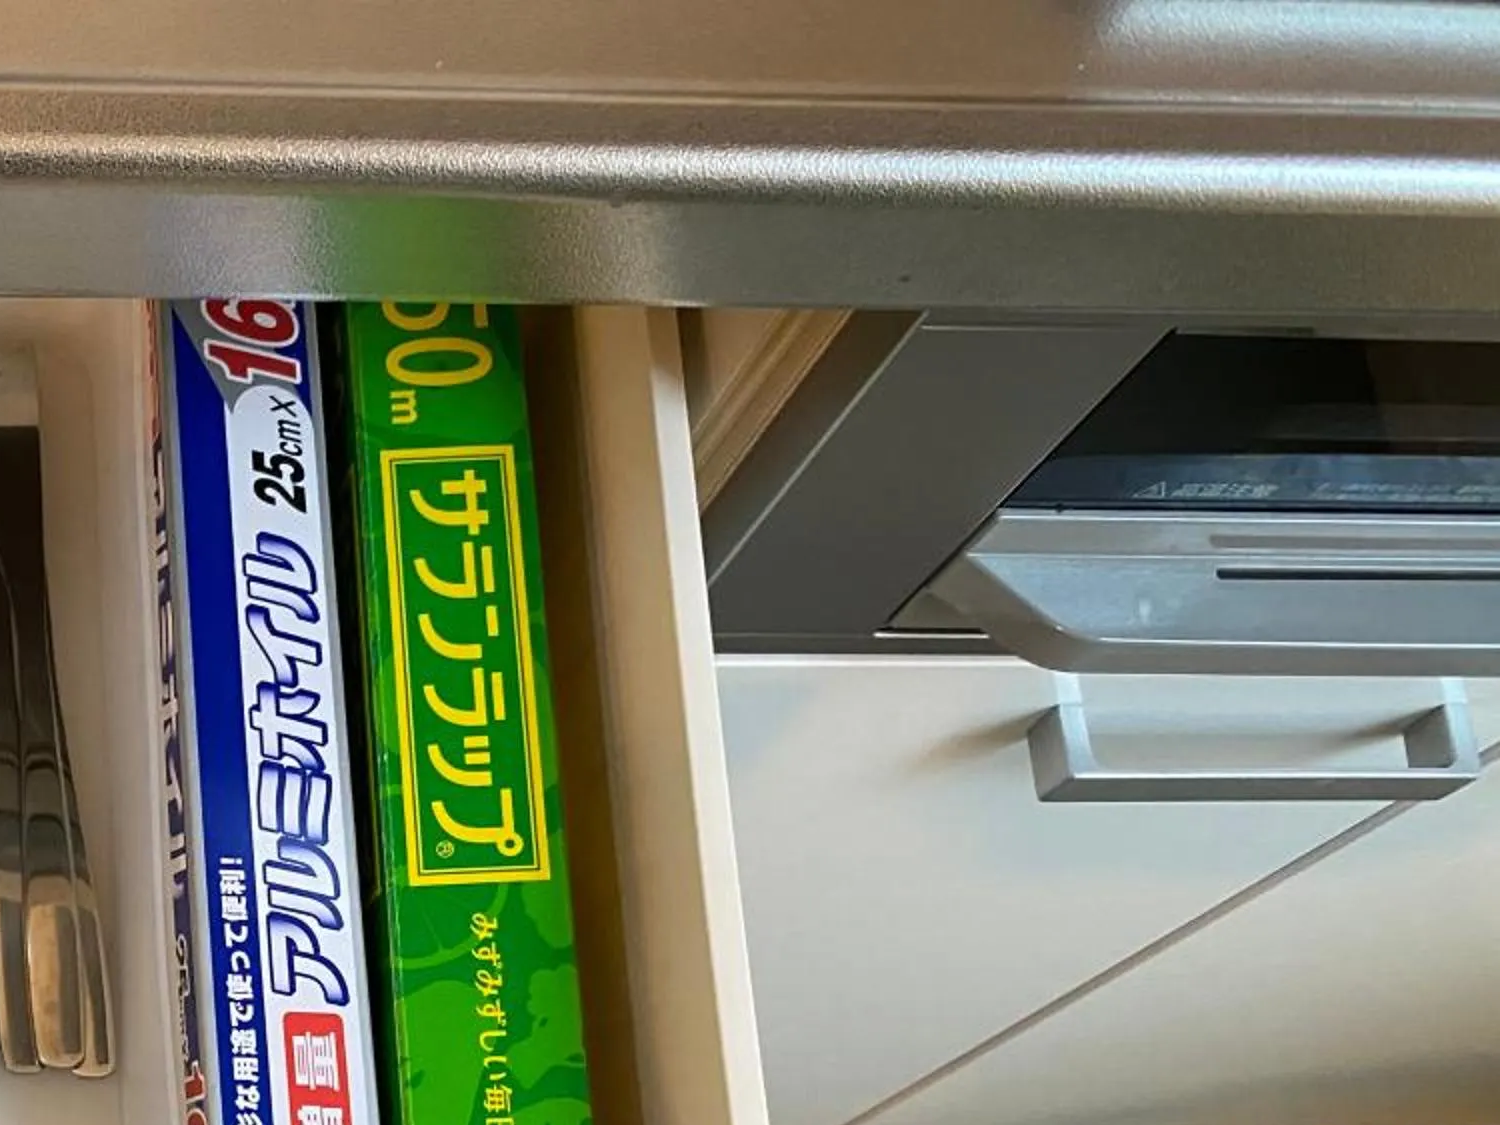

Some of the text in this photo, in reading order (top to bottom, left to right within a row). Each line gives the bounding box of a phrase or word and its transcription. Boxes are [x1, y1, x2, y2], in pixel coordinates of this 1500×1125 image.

[241, 531, 351, 1006] アルミホイル
[408, 469, 524, 857] サランラップ
